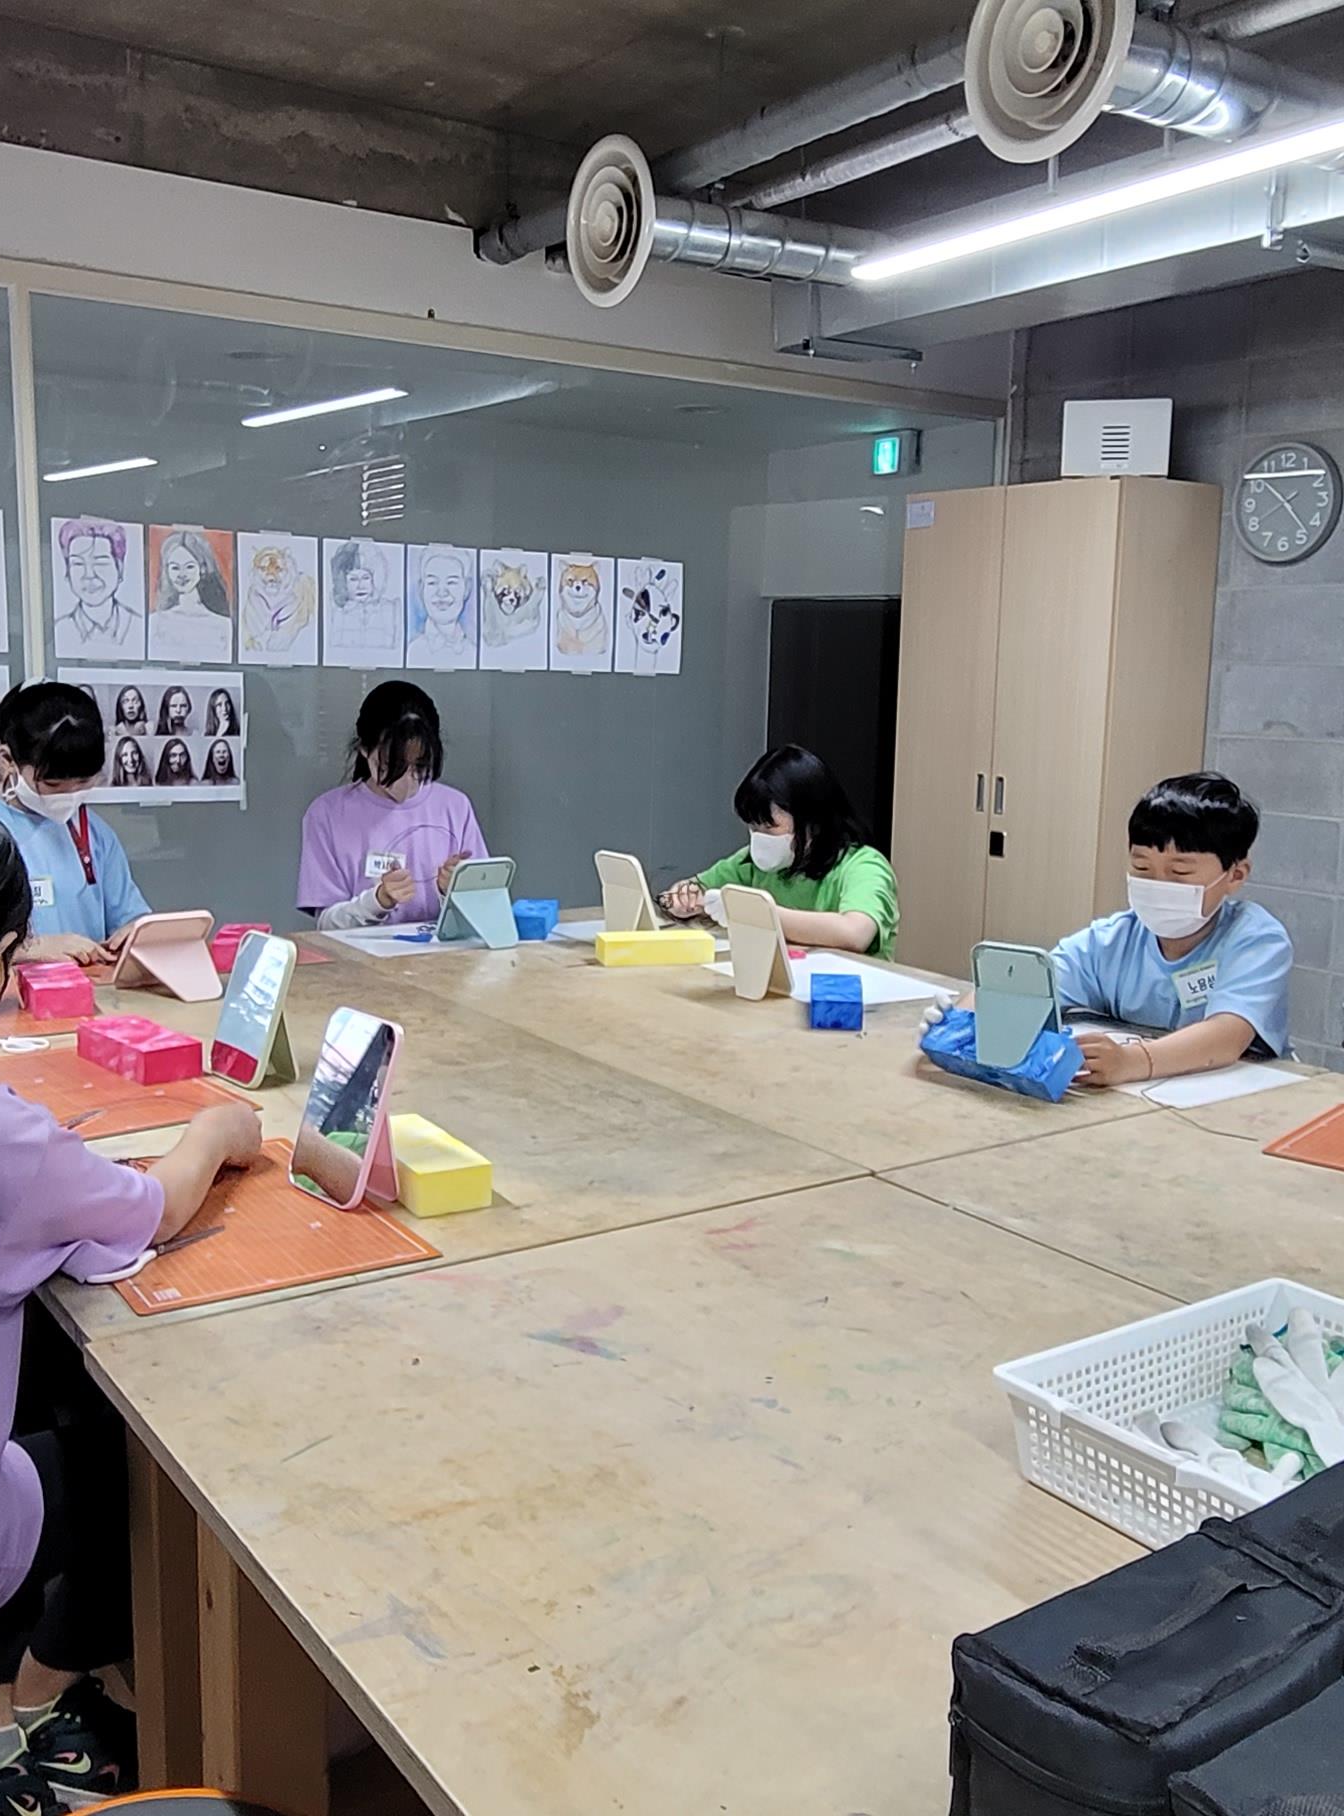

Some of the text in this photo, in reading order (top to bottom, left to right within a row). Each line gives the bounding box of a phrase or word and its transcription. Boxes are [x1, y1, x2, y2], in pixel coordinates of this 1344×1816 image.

[1263, 460, 1276, 472] 11
[1280, 453, 1297, 467] 12
[1303, 457, 1309, 470] 1
[1249, 479, 1266, 494] 10
[1312, 473, 1325, 488] 2
[1244, 498, 1256, 513] 9
[1316, 491, 1329, 507] 3
[1248, 516, 1260, 532] 8
[1309, 512, 1321, 527] 4
[1261, 531, 1273, 547] 7
[1277, 537, 1289, 552] 6
[1296, 529, 1308, 545] 5
